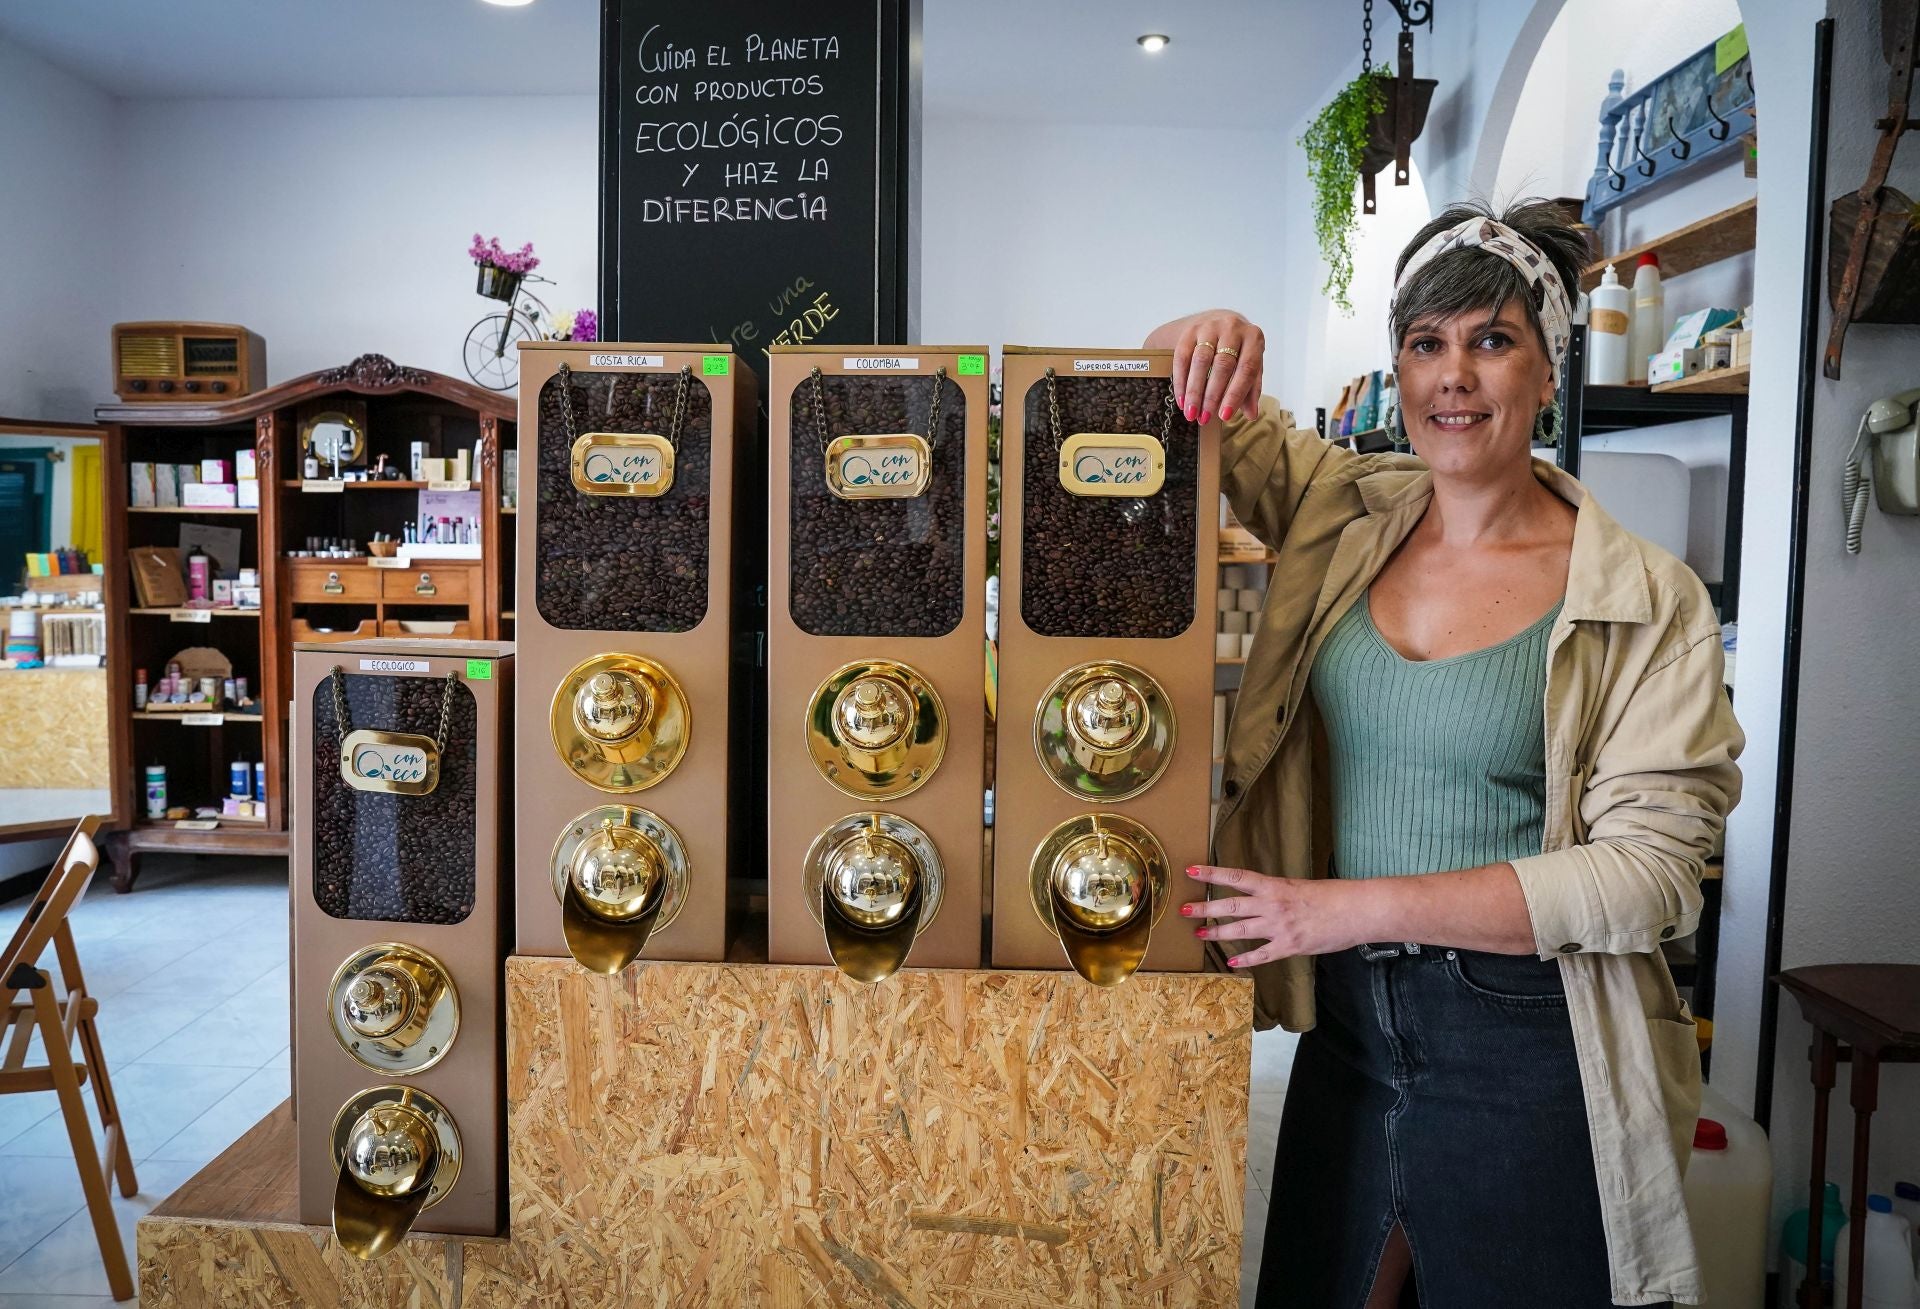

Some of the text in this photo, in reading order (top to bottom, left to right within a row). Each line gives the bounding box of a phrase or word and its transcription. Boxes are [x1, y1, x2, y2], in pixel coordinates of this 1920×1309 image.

[707, 45, 731, 66] EL
[746, 34, 839, 62] PLANETA
[636, 75, 823, 104] CON PRODUCTOS
[682, 158, 828, 187] Y HAZ LA
[643, 192, 828, 223] DIFERENCIA
[769, 276, 815, 316] una
[595, 355, 648, 366] COSTA RICA
[856, 358, 901, 369] COLOMBIA
[1075, 361, 1111, 371] SUPERIOR
[623, 454, 655, 468] con
[881, 454, 913, 468] con
[1114, 455, 1148, 469] con
[622, 470, 654, 484] eco
[881, 470, 913, 485] eco
[1114, 471, 1147, 484] eco
[371, 660, 416, 671] ECOLOGICO
[393, 752, 424, 766] con
[392, 768, 423, 782] eco
